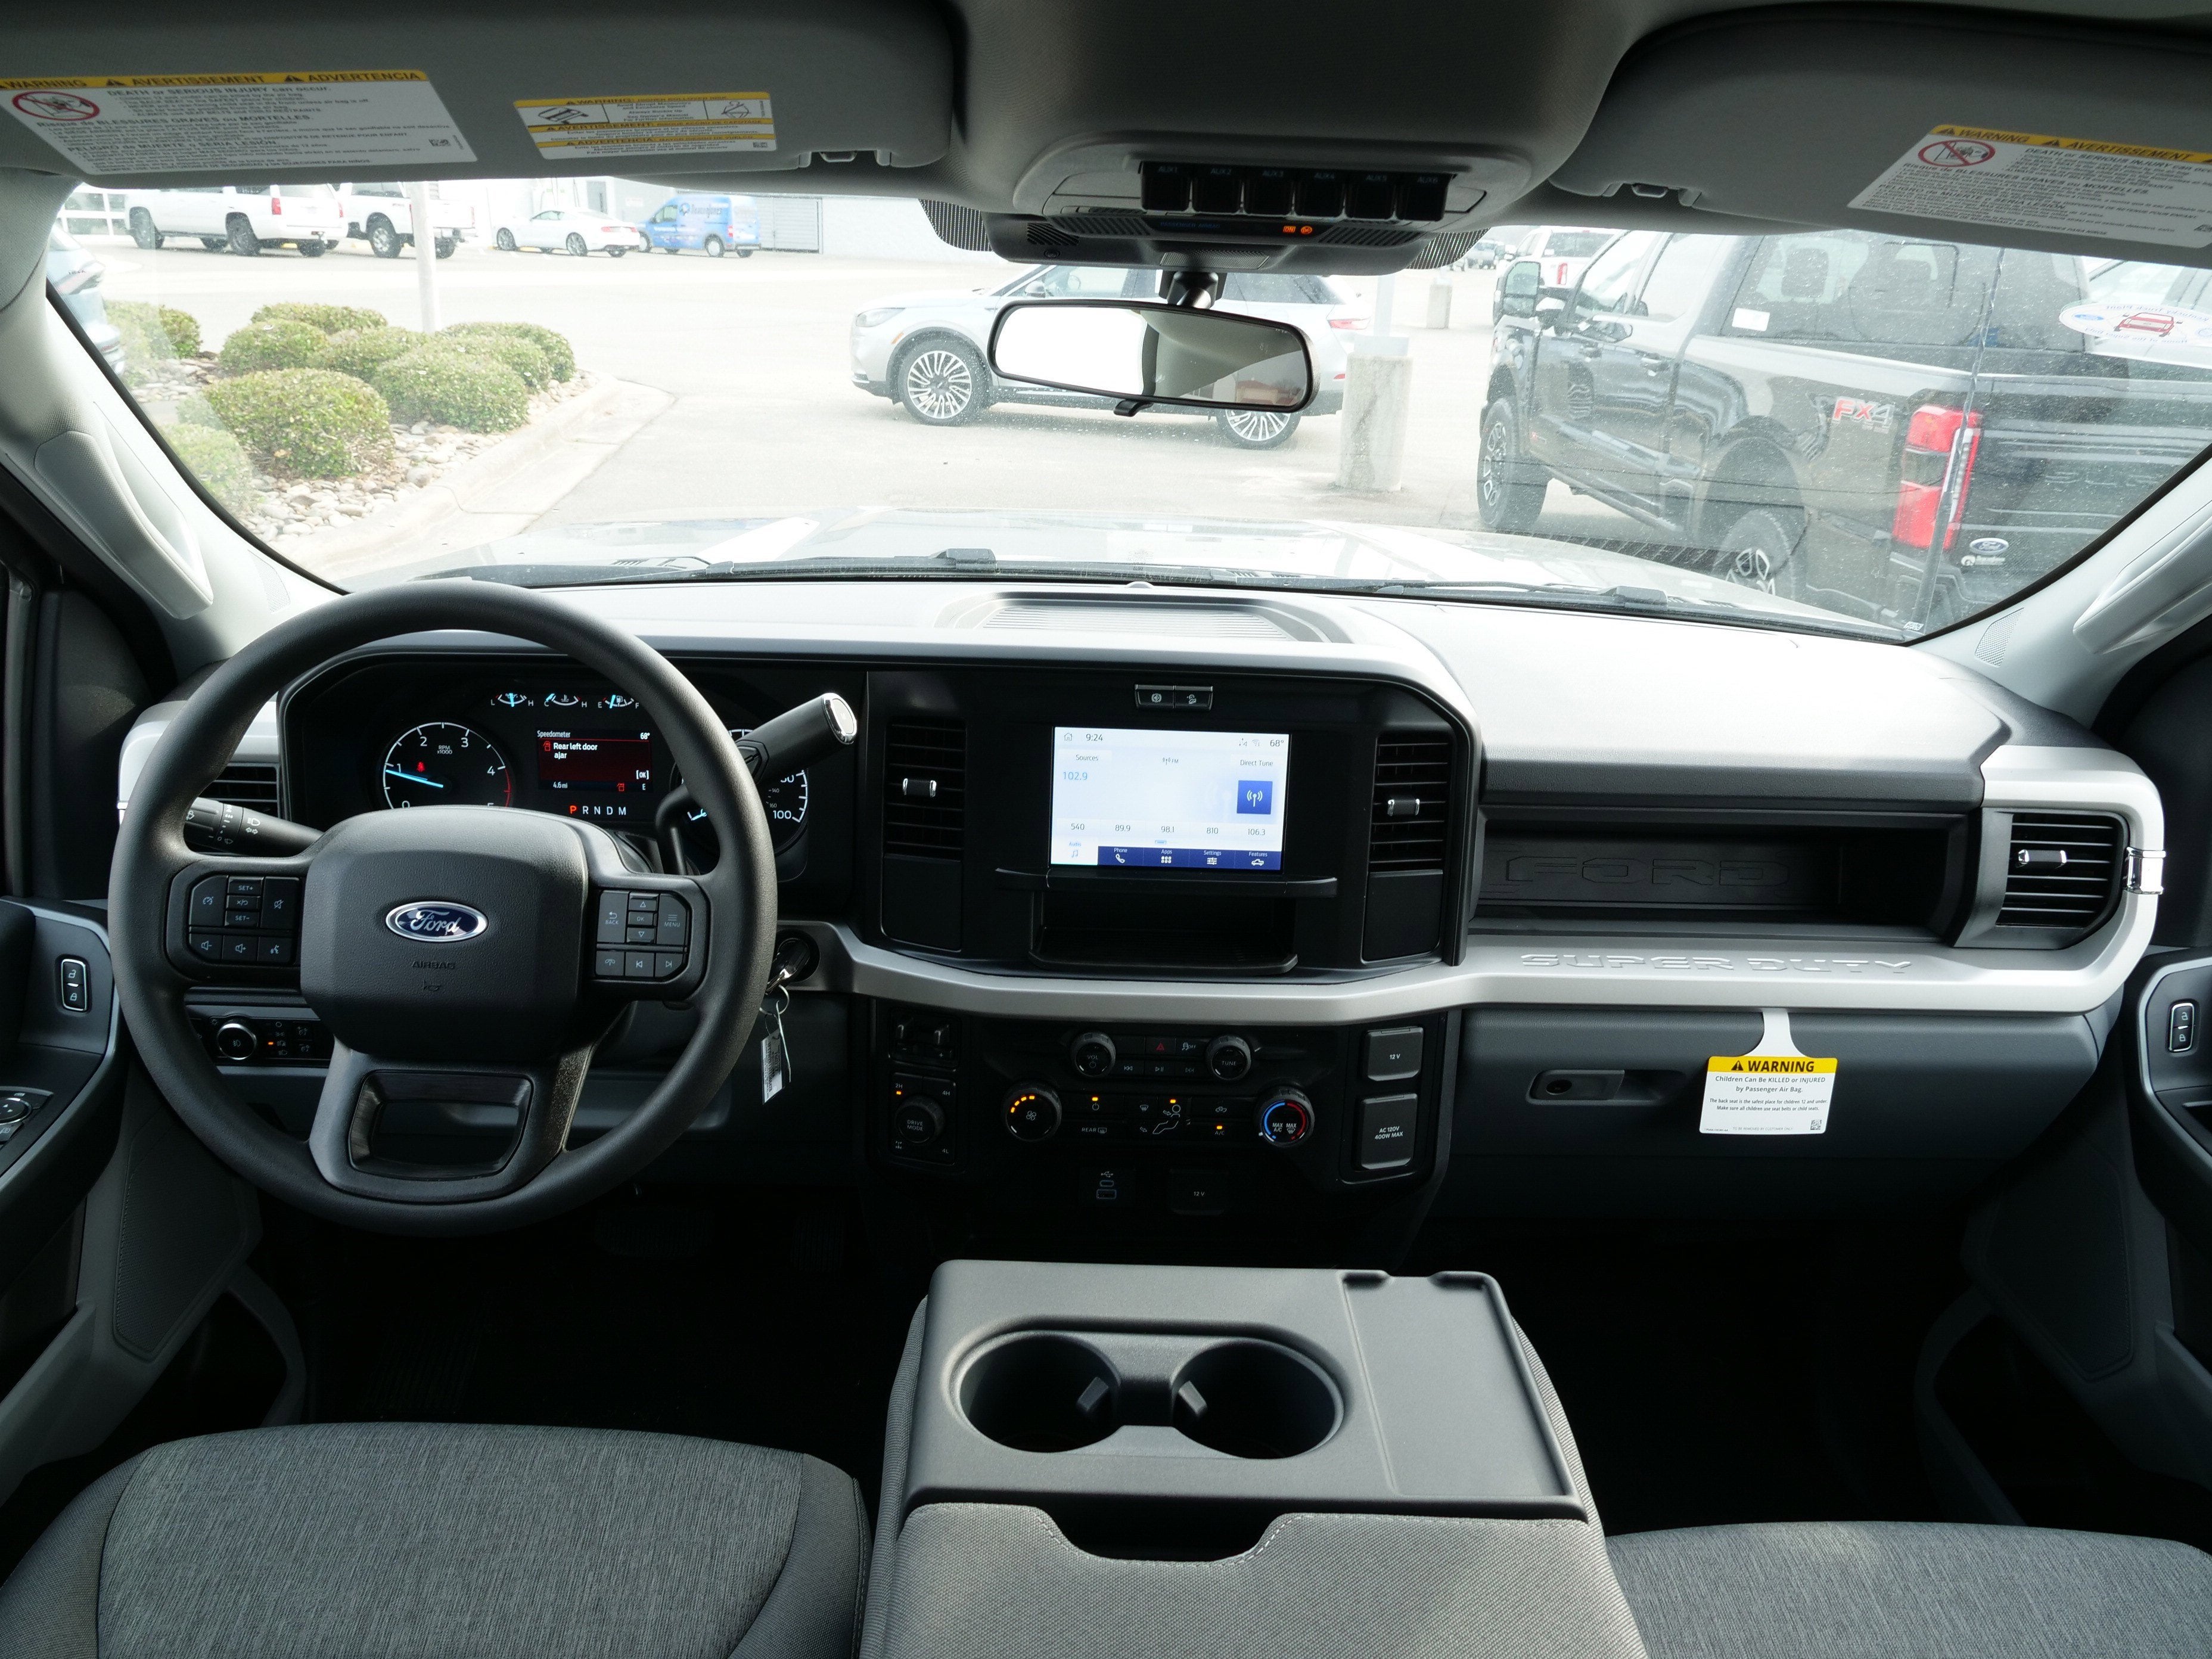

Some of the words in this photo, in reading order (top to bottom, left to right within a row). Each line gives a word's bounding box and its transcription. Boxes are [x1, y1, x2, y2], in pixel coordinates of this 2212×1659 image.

[307, 72, 421, 83] ADVERTENCIA
[1960, 128, 2031, 144] WARNING
[1833, 396, 1895, 428] FX4
[537, 730, 571, 739] Speedometer
[1085, 734, 1104, 742] 9:24
[420, 736, 427, 747] 2
[461, 737, 469, 748] 3
[553, 742, 568, 751] Rear
[569, 742, 582, 751] left
[582, 742, 598, 751] door
[554, 751, 567, 760] ajar
[1258, 759, 1273, 768] Tune
[487, 765, 496, 776] 4
[1062, 771, 1088, 781] 102.9
[570, 805, 577, 814] P
[582, 806, 589, 815] R
[594, 806, 601, 815] N
[607, 806, 613, 816] D
[618, 806, 627, 816] M
[772, 810, 792, 819] 100
[1505, 855, 1788, 887] FORD
[410, 909, 462, 934] Ford
[411, 960, 456, 970] AIRBAG
[1520, 953, 1735, 971] SUPER
[1746, 957, 1912, 974] DUTY
[1748, 1060, 1815, 1073] WARNING
[906, 1124, 924, 1132] MODE
